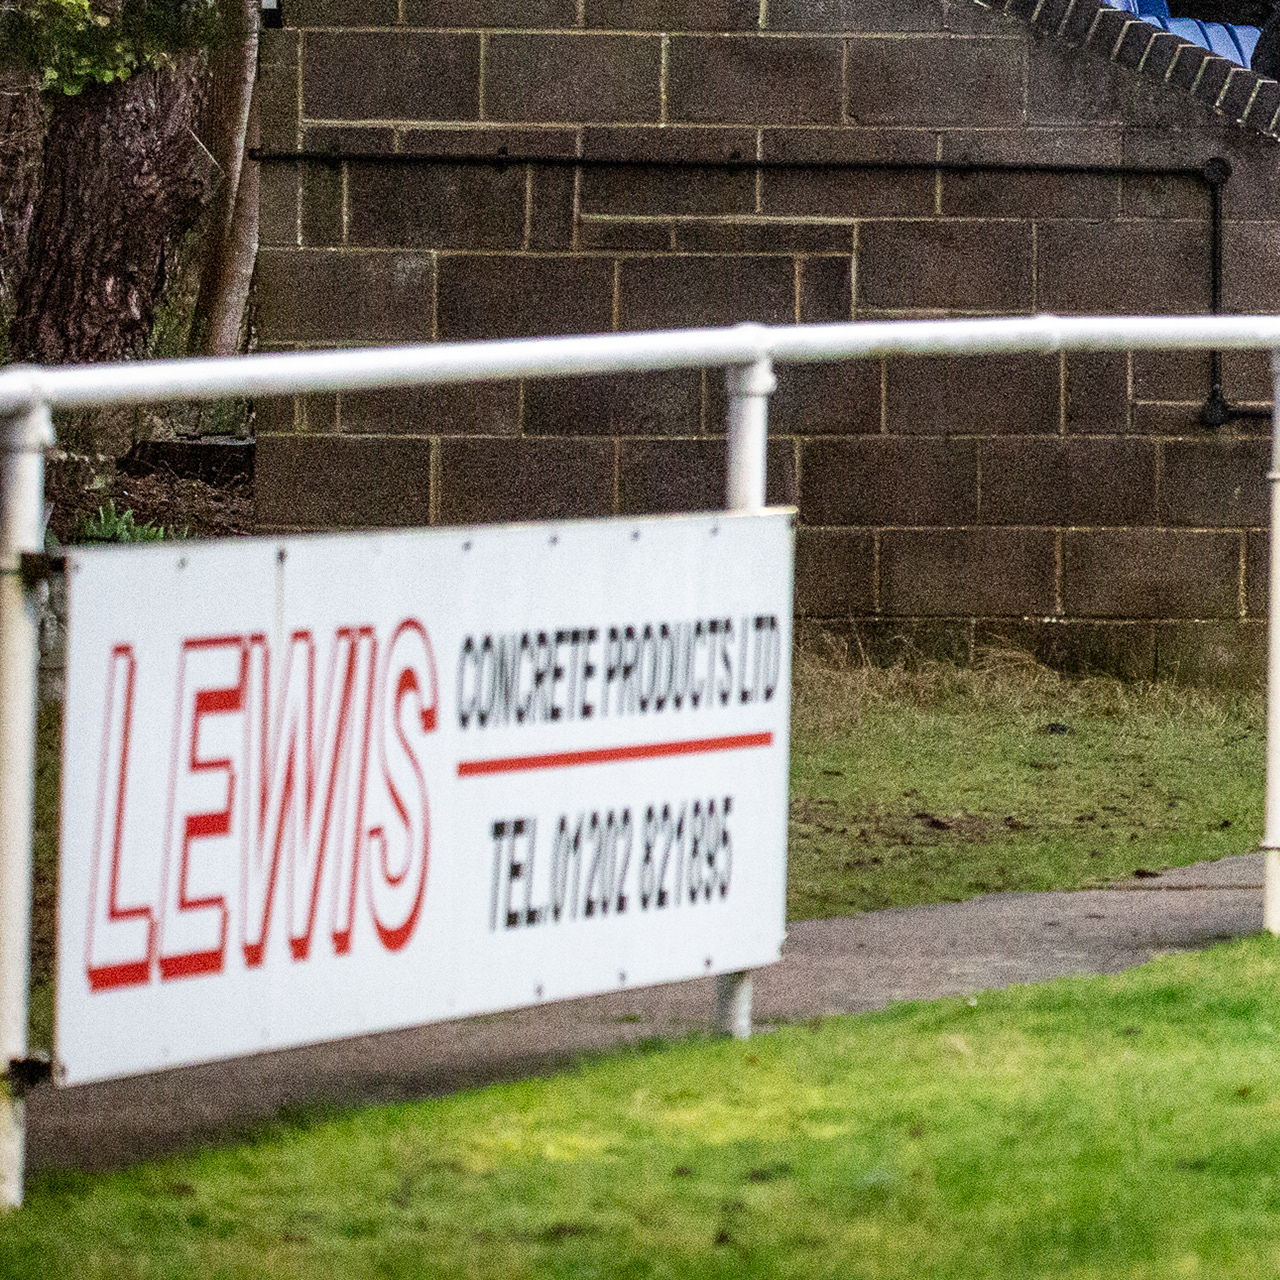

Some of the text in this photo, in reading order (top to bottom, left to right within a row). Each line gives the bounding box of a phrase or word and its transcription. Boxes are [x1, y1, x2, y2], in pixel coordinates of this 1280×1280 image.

[457, 614, 781, 730] CONCRETE PRODUCTS LTD
[87, 617, 438, 994] LEWIS
[638, 795, 734, 911] 821895
